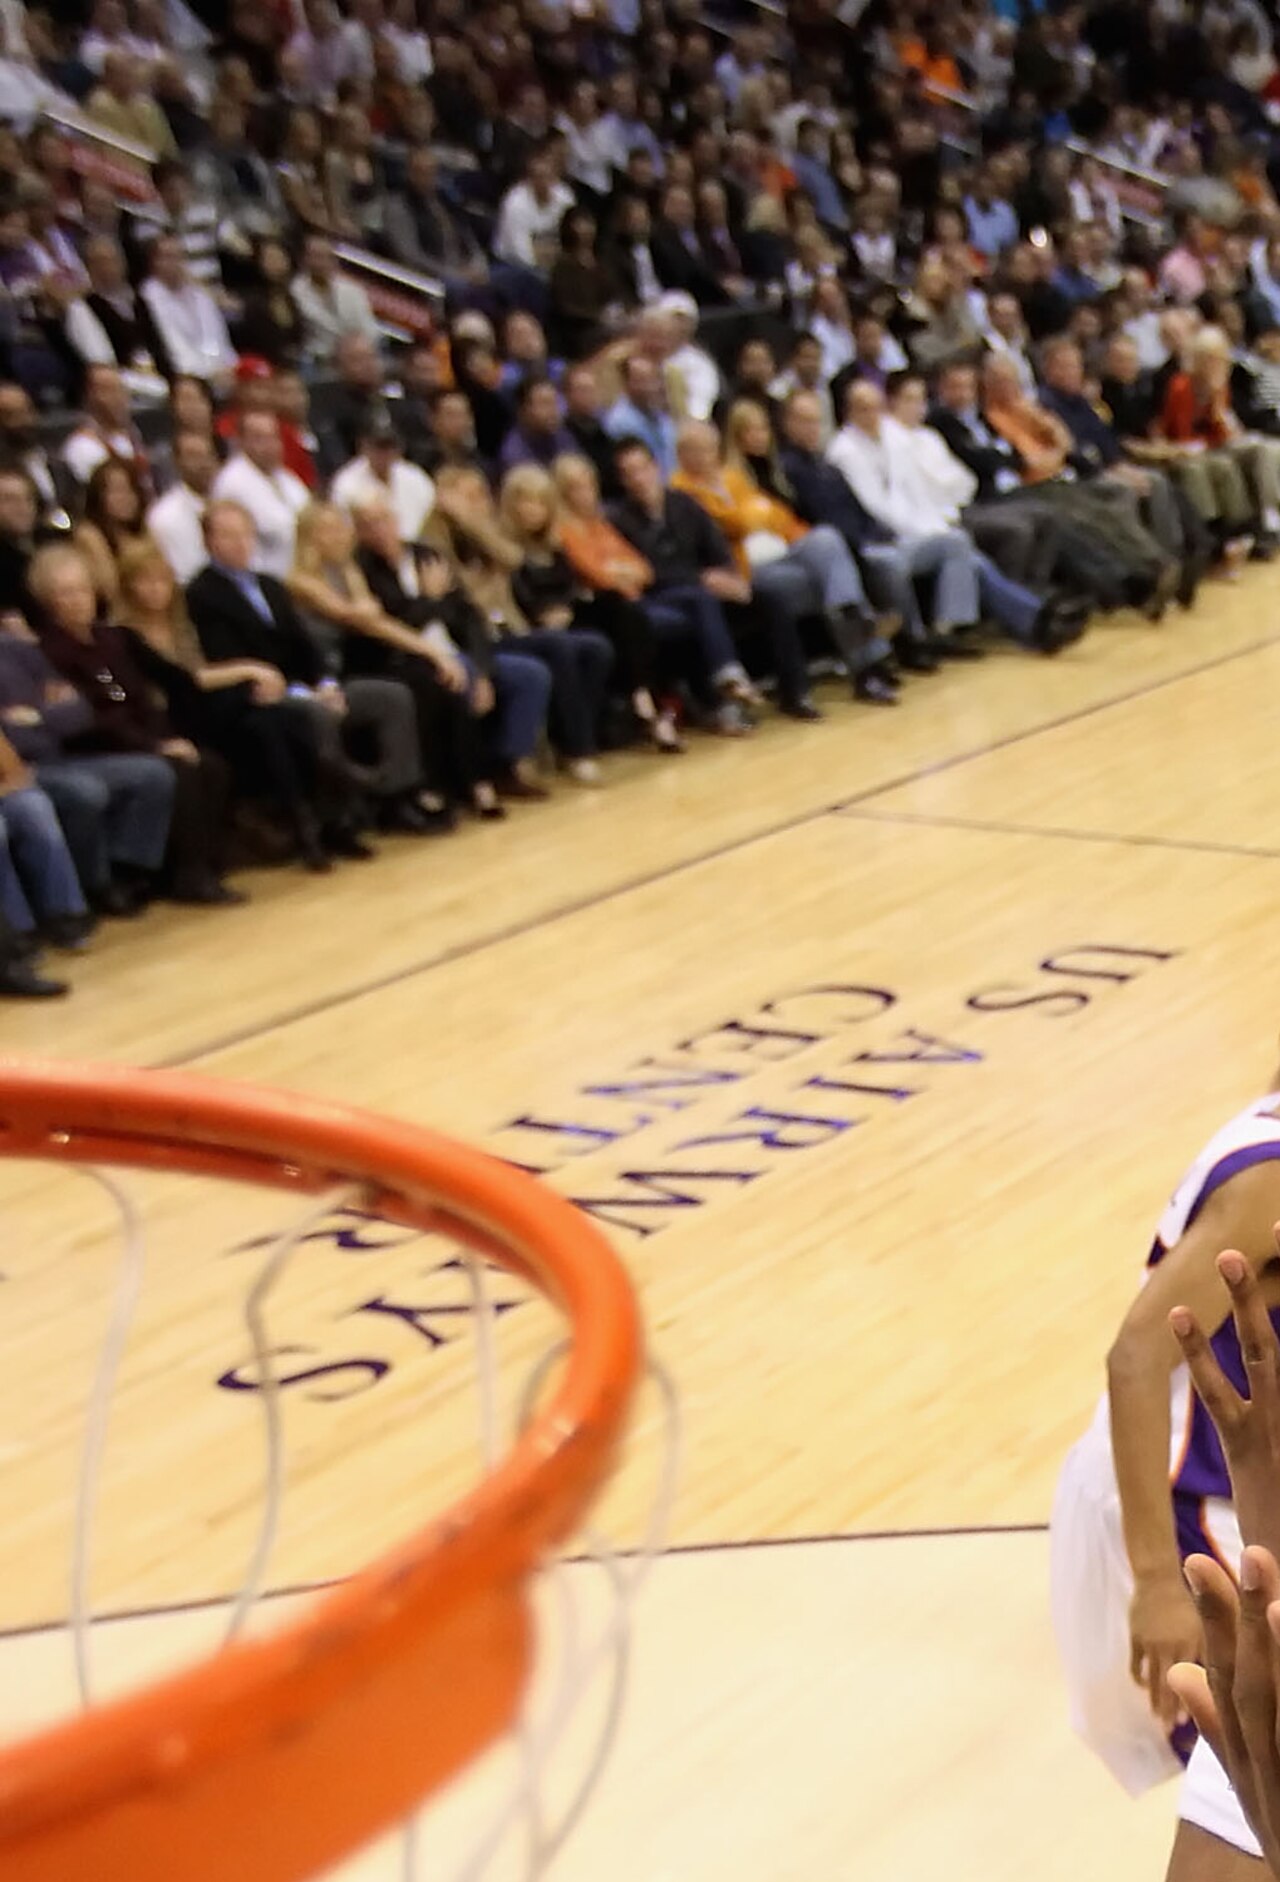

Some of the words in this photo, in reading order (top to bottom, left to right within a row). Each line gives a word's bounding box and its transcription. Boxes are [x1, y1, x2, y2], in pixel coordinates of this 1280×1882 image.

[965, 942, 1184, 1018] US
[214, 1028, 985, 1402] AIRWYS
[222, 983, 897, 1258] CENTR
